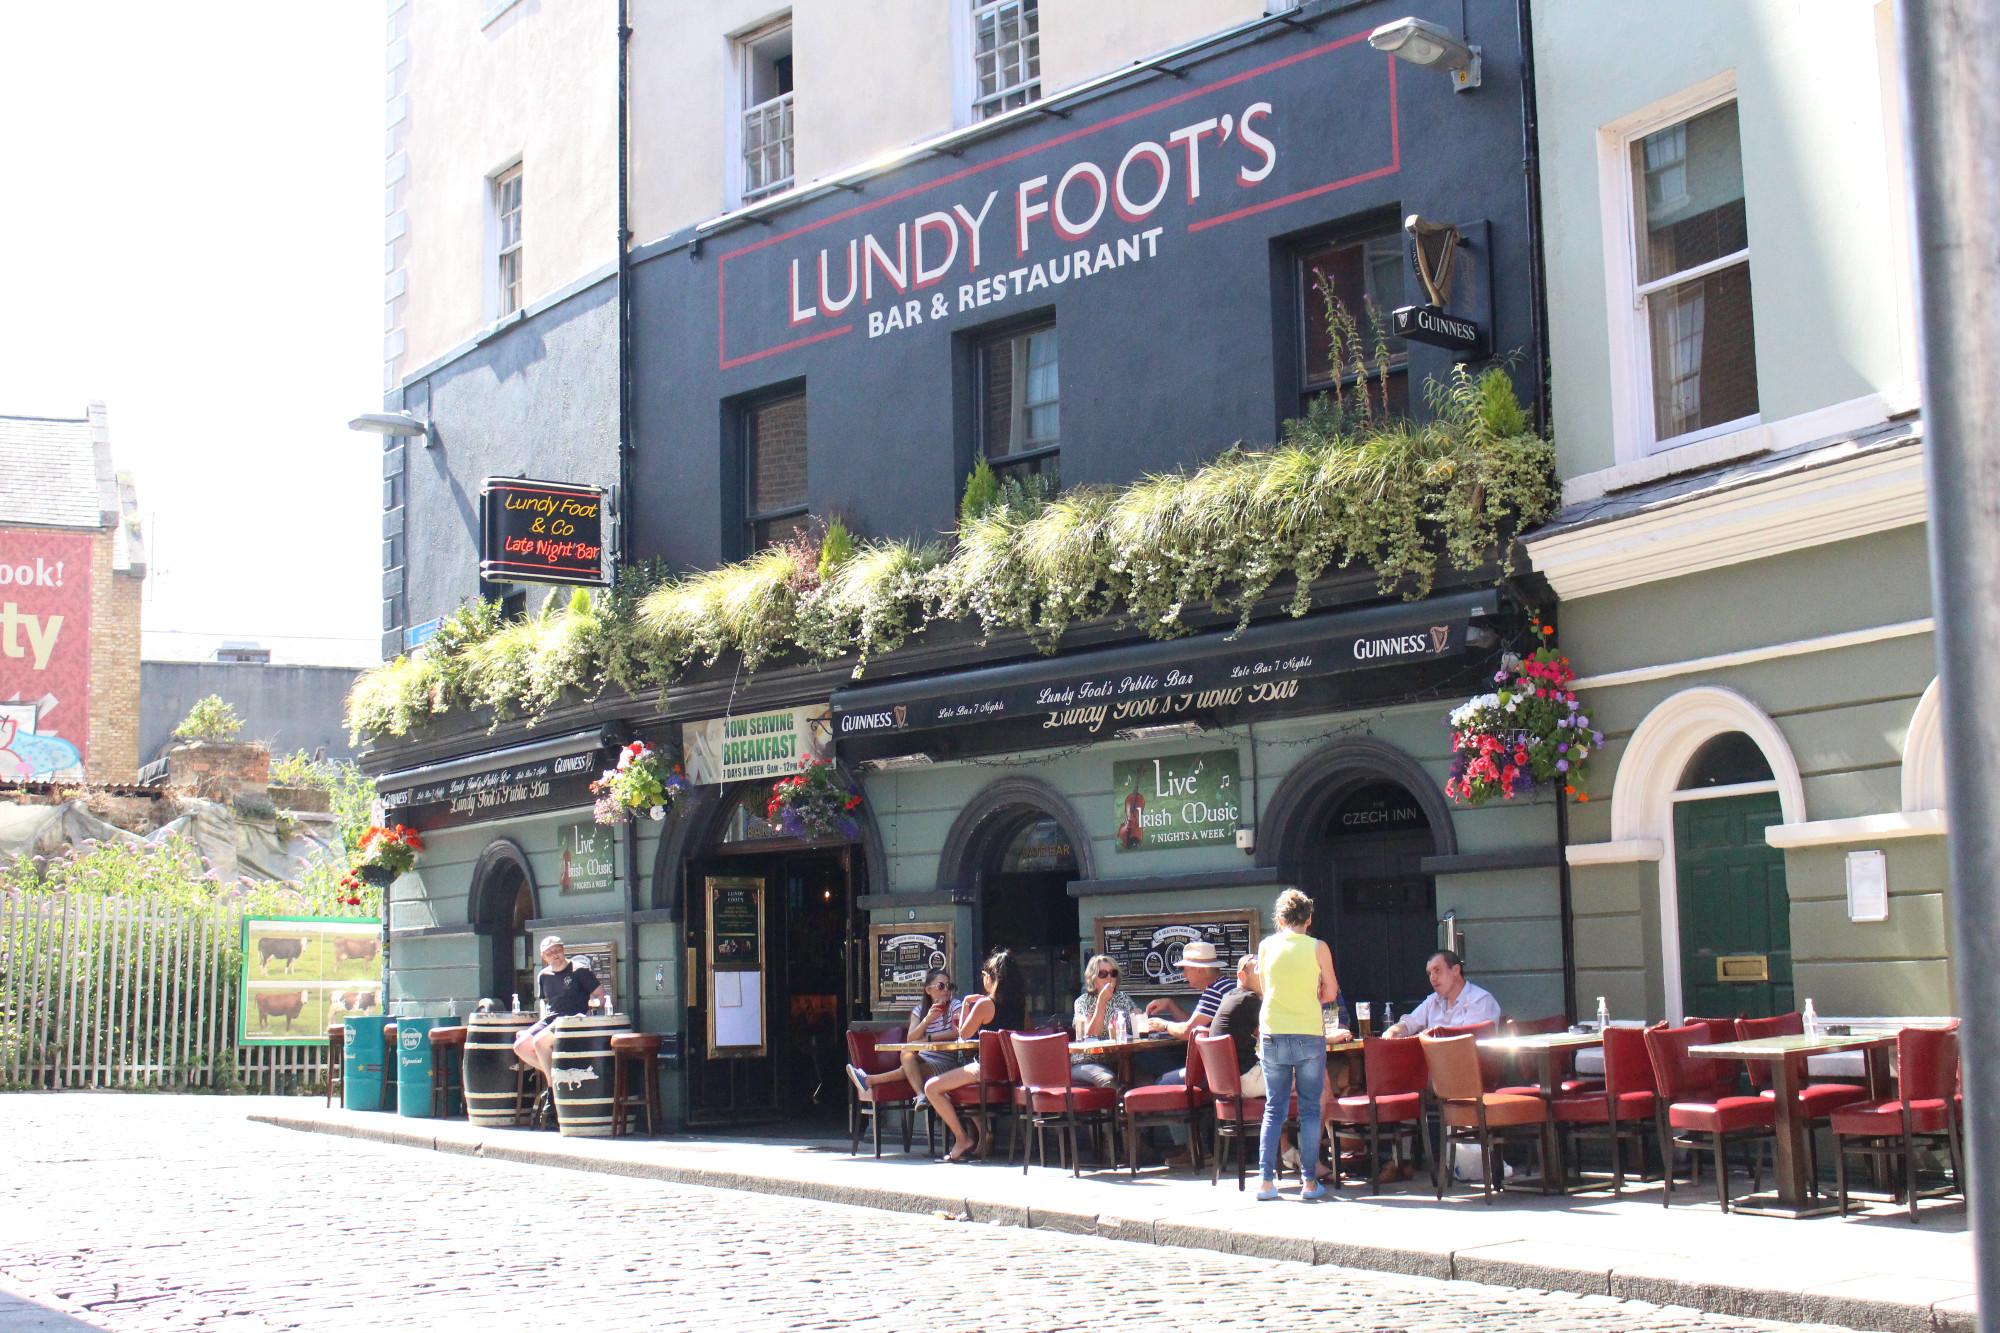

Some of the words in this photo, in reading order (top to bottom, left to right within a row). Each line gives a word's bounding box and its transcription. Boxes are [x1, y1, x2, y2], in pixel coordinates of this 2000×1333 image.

[790, 190, 999, 326] LUNDY
[1018, 102, 1277, 255] FOOT'S
[867, 296, 923, 339] BAR
[930, 292, 949, 320] &
[958, 227, 1165, 313] RESTAURANT
[1418, 311, 1476, 341] GUINNESS
[505, 493, 559, 516] Lundy
[560, 499, 599, 518] Foot
[531, 517, 546, 534] &
[551, 519, 574, 536] Co
[505, 535, 534, 553] Late
[536, 540, 573, 563] Night
[576, 543, 600, 560] Bar
[1353, 634, 1426, 660] GUINNESS
[1253, 662, 1272, 675] Bar
[1036, 686, 1074, 706] Lundy
[1078, 680, 1113, 699] Foot's
[1117, 675, 1159, 694] Public
[1164, 669, 1193, 687] Bar
[724, 719, 747, 739] NOW
[749, 713, 794, 736] SERVING
[841, 712, 892, 732] GUINNESS
[722, 734, 797, 765] BREAKFAST
[554, 755, 586, 774] GUINNESS
[727, 767, 742, 778] DAYS
[743, 766, 747, 777] A
[748, 765, 765, 777] WEEK
[767, 764, 778, 774] 9AM
[529, 780, 550, 799] Bar
[1152, 759, 1198, 797] Live
[1136, 807, 1172, 828] Irish
[1182, 801, 1239, 824] Music
[1343, 810, 1388, 825] CZECH
[1393, 807, 1416, 821] INN
[574, 825, 594, 855] Live
[1151, 834, 1156, 843] 7
[1157, 831, 1190, 843] NIGHTS
[1191, 830, 1198, 840] A
[1200, 828, 1225, 840] WEEK
[587, 858, 613, 876] Music
